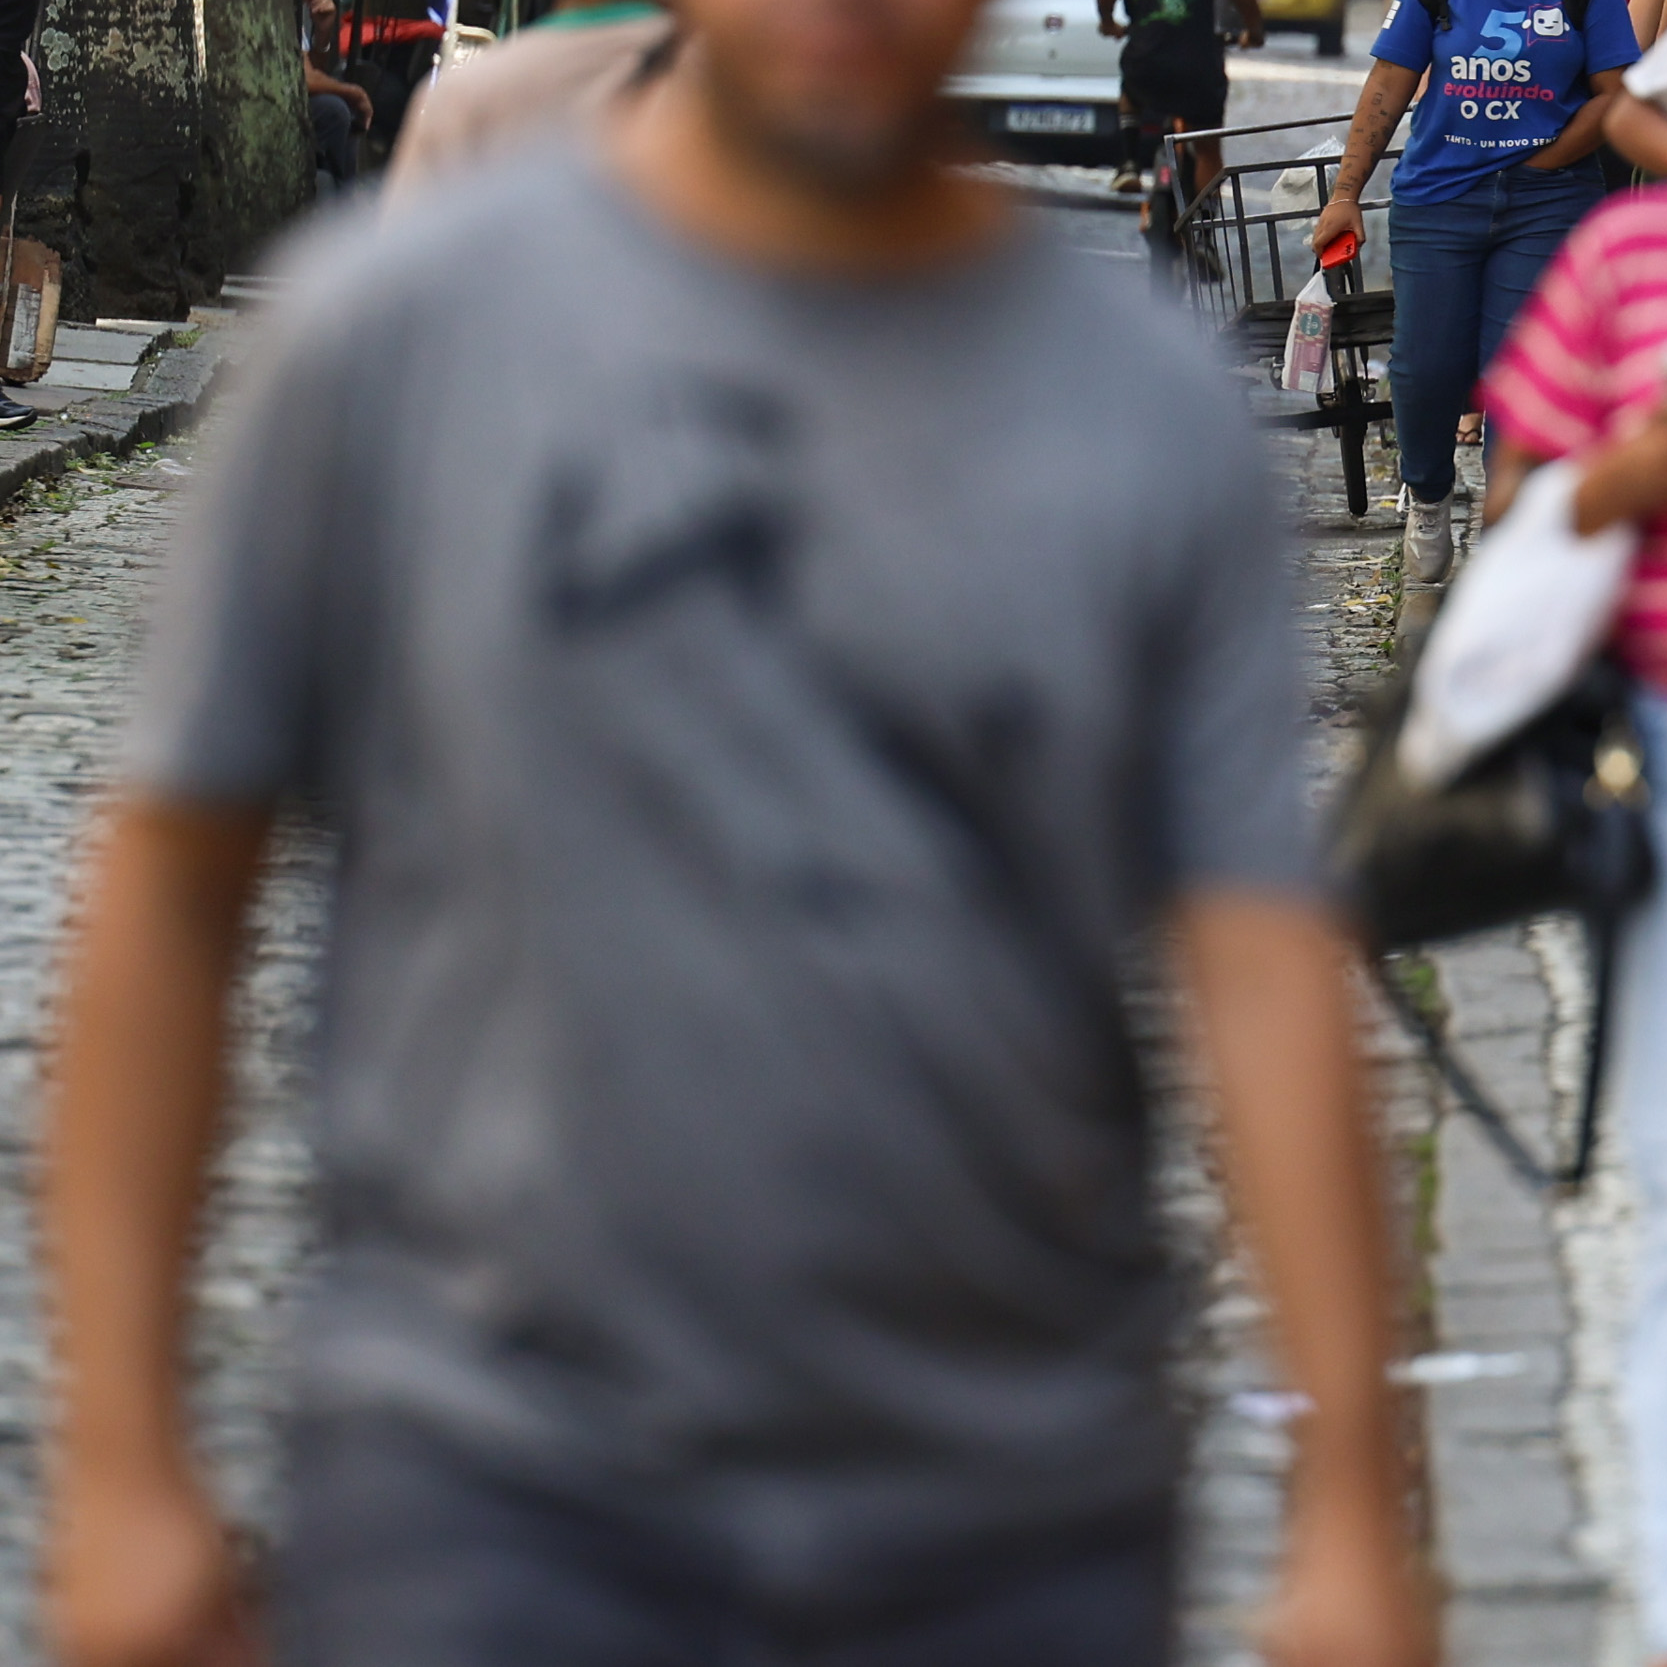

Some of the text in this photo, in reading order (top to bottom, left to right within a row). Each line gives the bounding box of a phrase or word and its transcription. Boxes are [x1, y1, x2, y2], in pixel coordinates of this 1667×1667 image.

[1472, 9, 1526, 61] 5
[1451, 55, 1531, 82] anos
[1444, 82, 1555, 102] evoluindo
[1460, 100, 1522, 121] O CX
[1480, 140, 1496, 148] UM
[1499, 139, 1529, 148] NOVO
